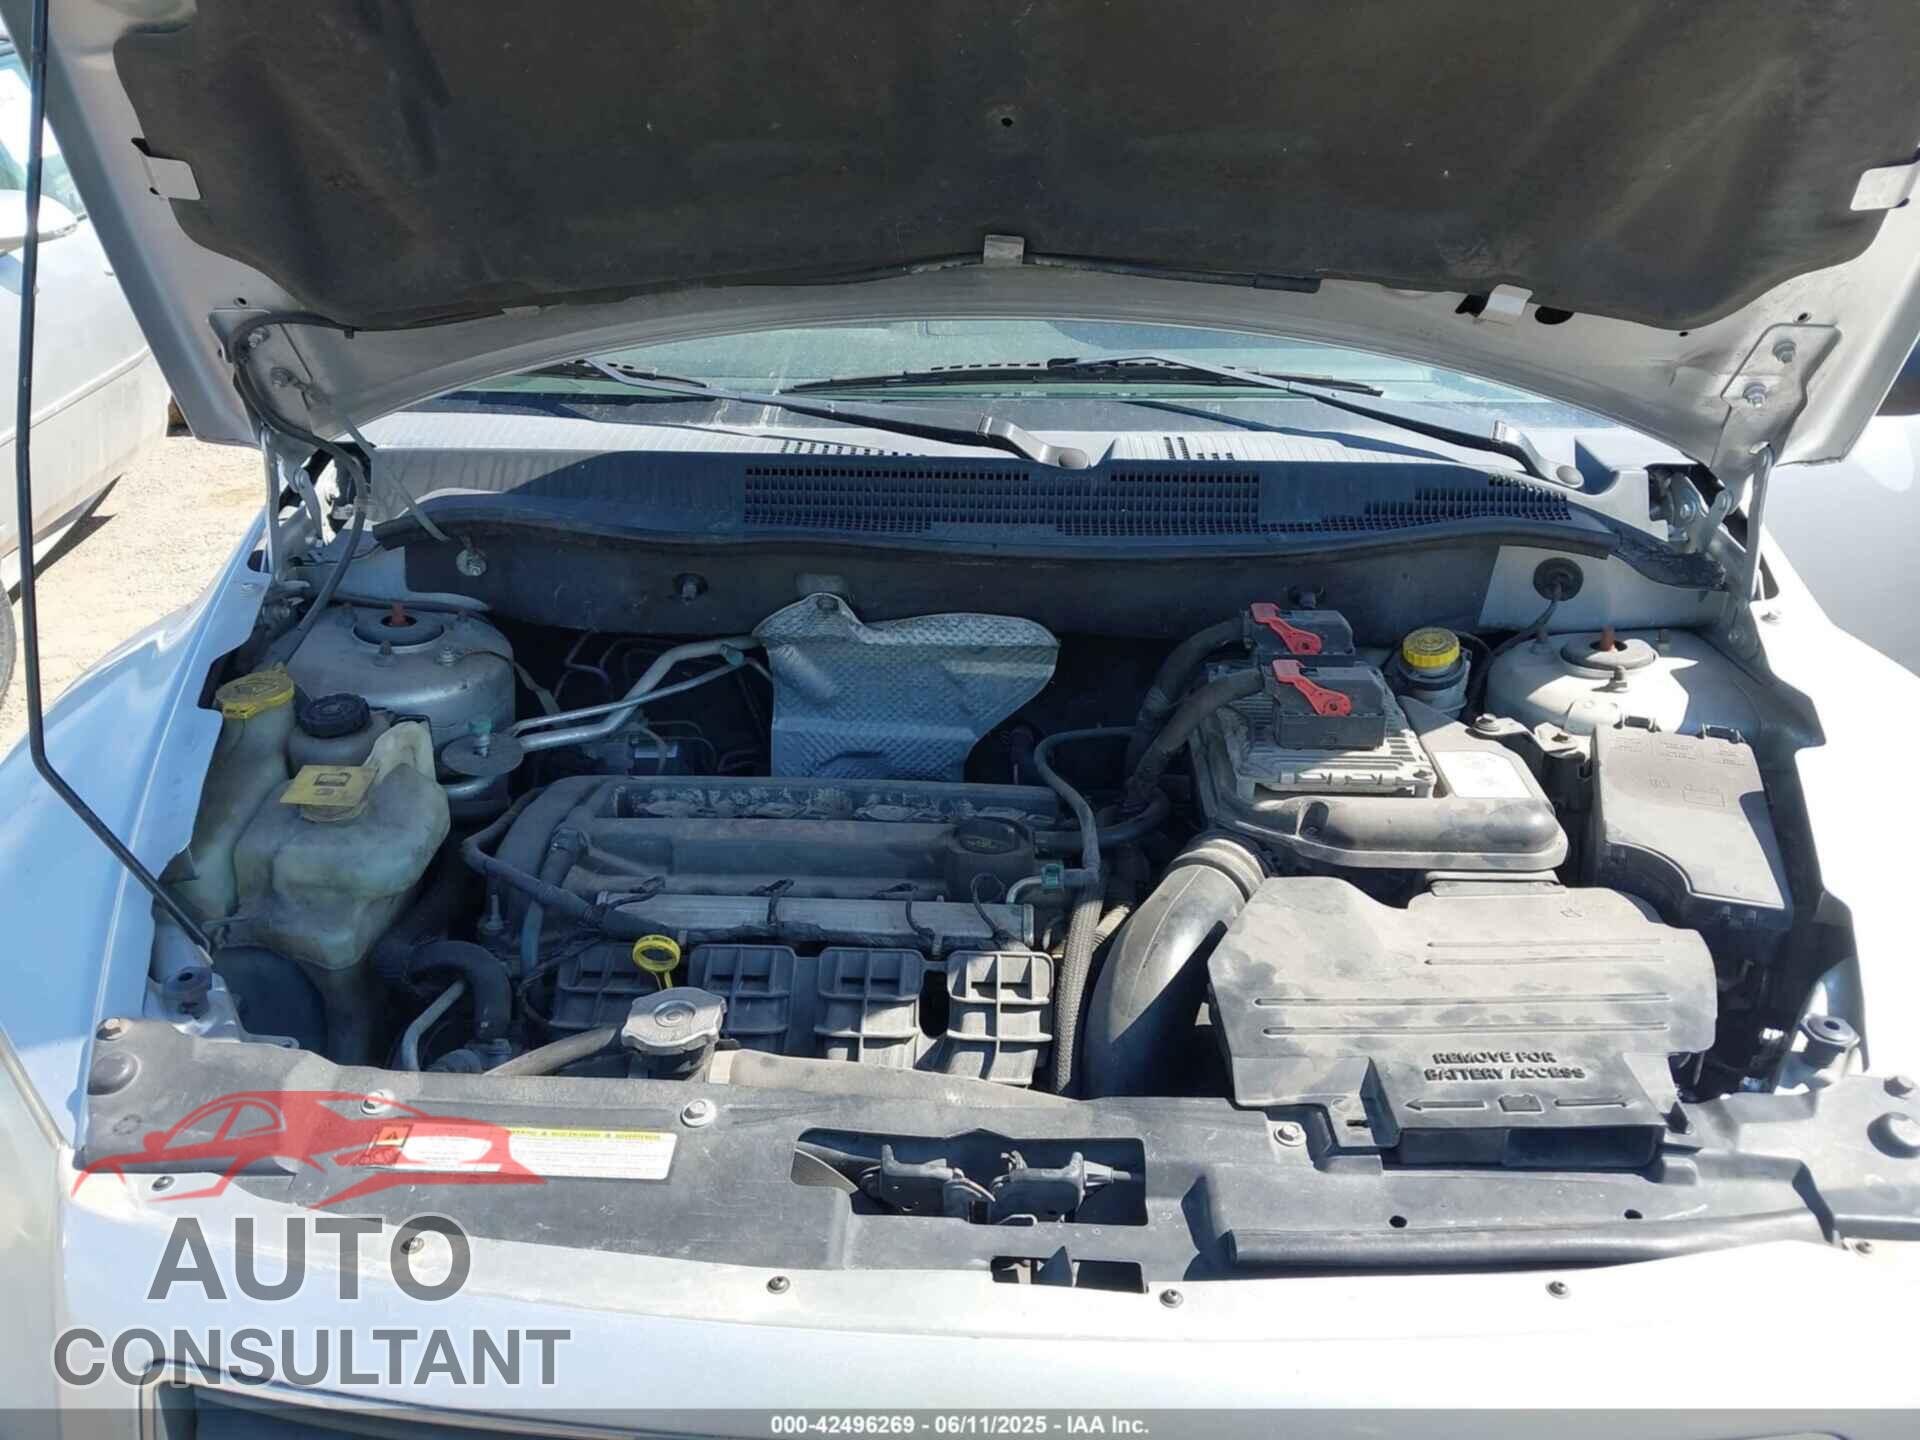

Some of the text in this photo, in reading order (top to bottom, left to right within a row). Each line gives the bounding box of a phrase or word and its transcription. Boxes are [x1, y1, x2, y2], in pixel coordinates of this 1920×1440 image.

[1432, 1051, 1557, 1064] REMOVE FOR
[1424, 1067, 1586, 1081] BATTERY ACCESS
